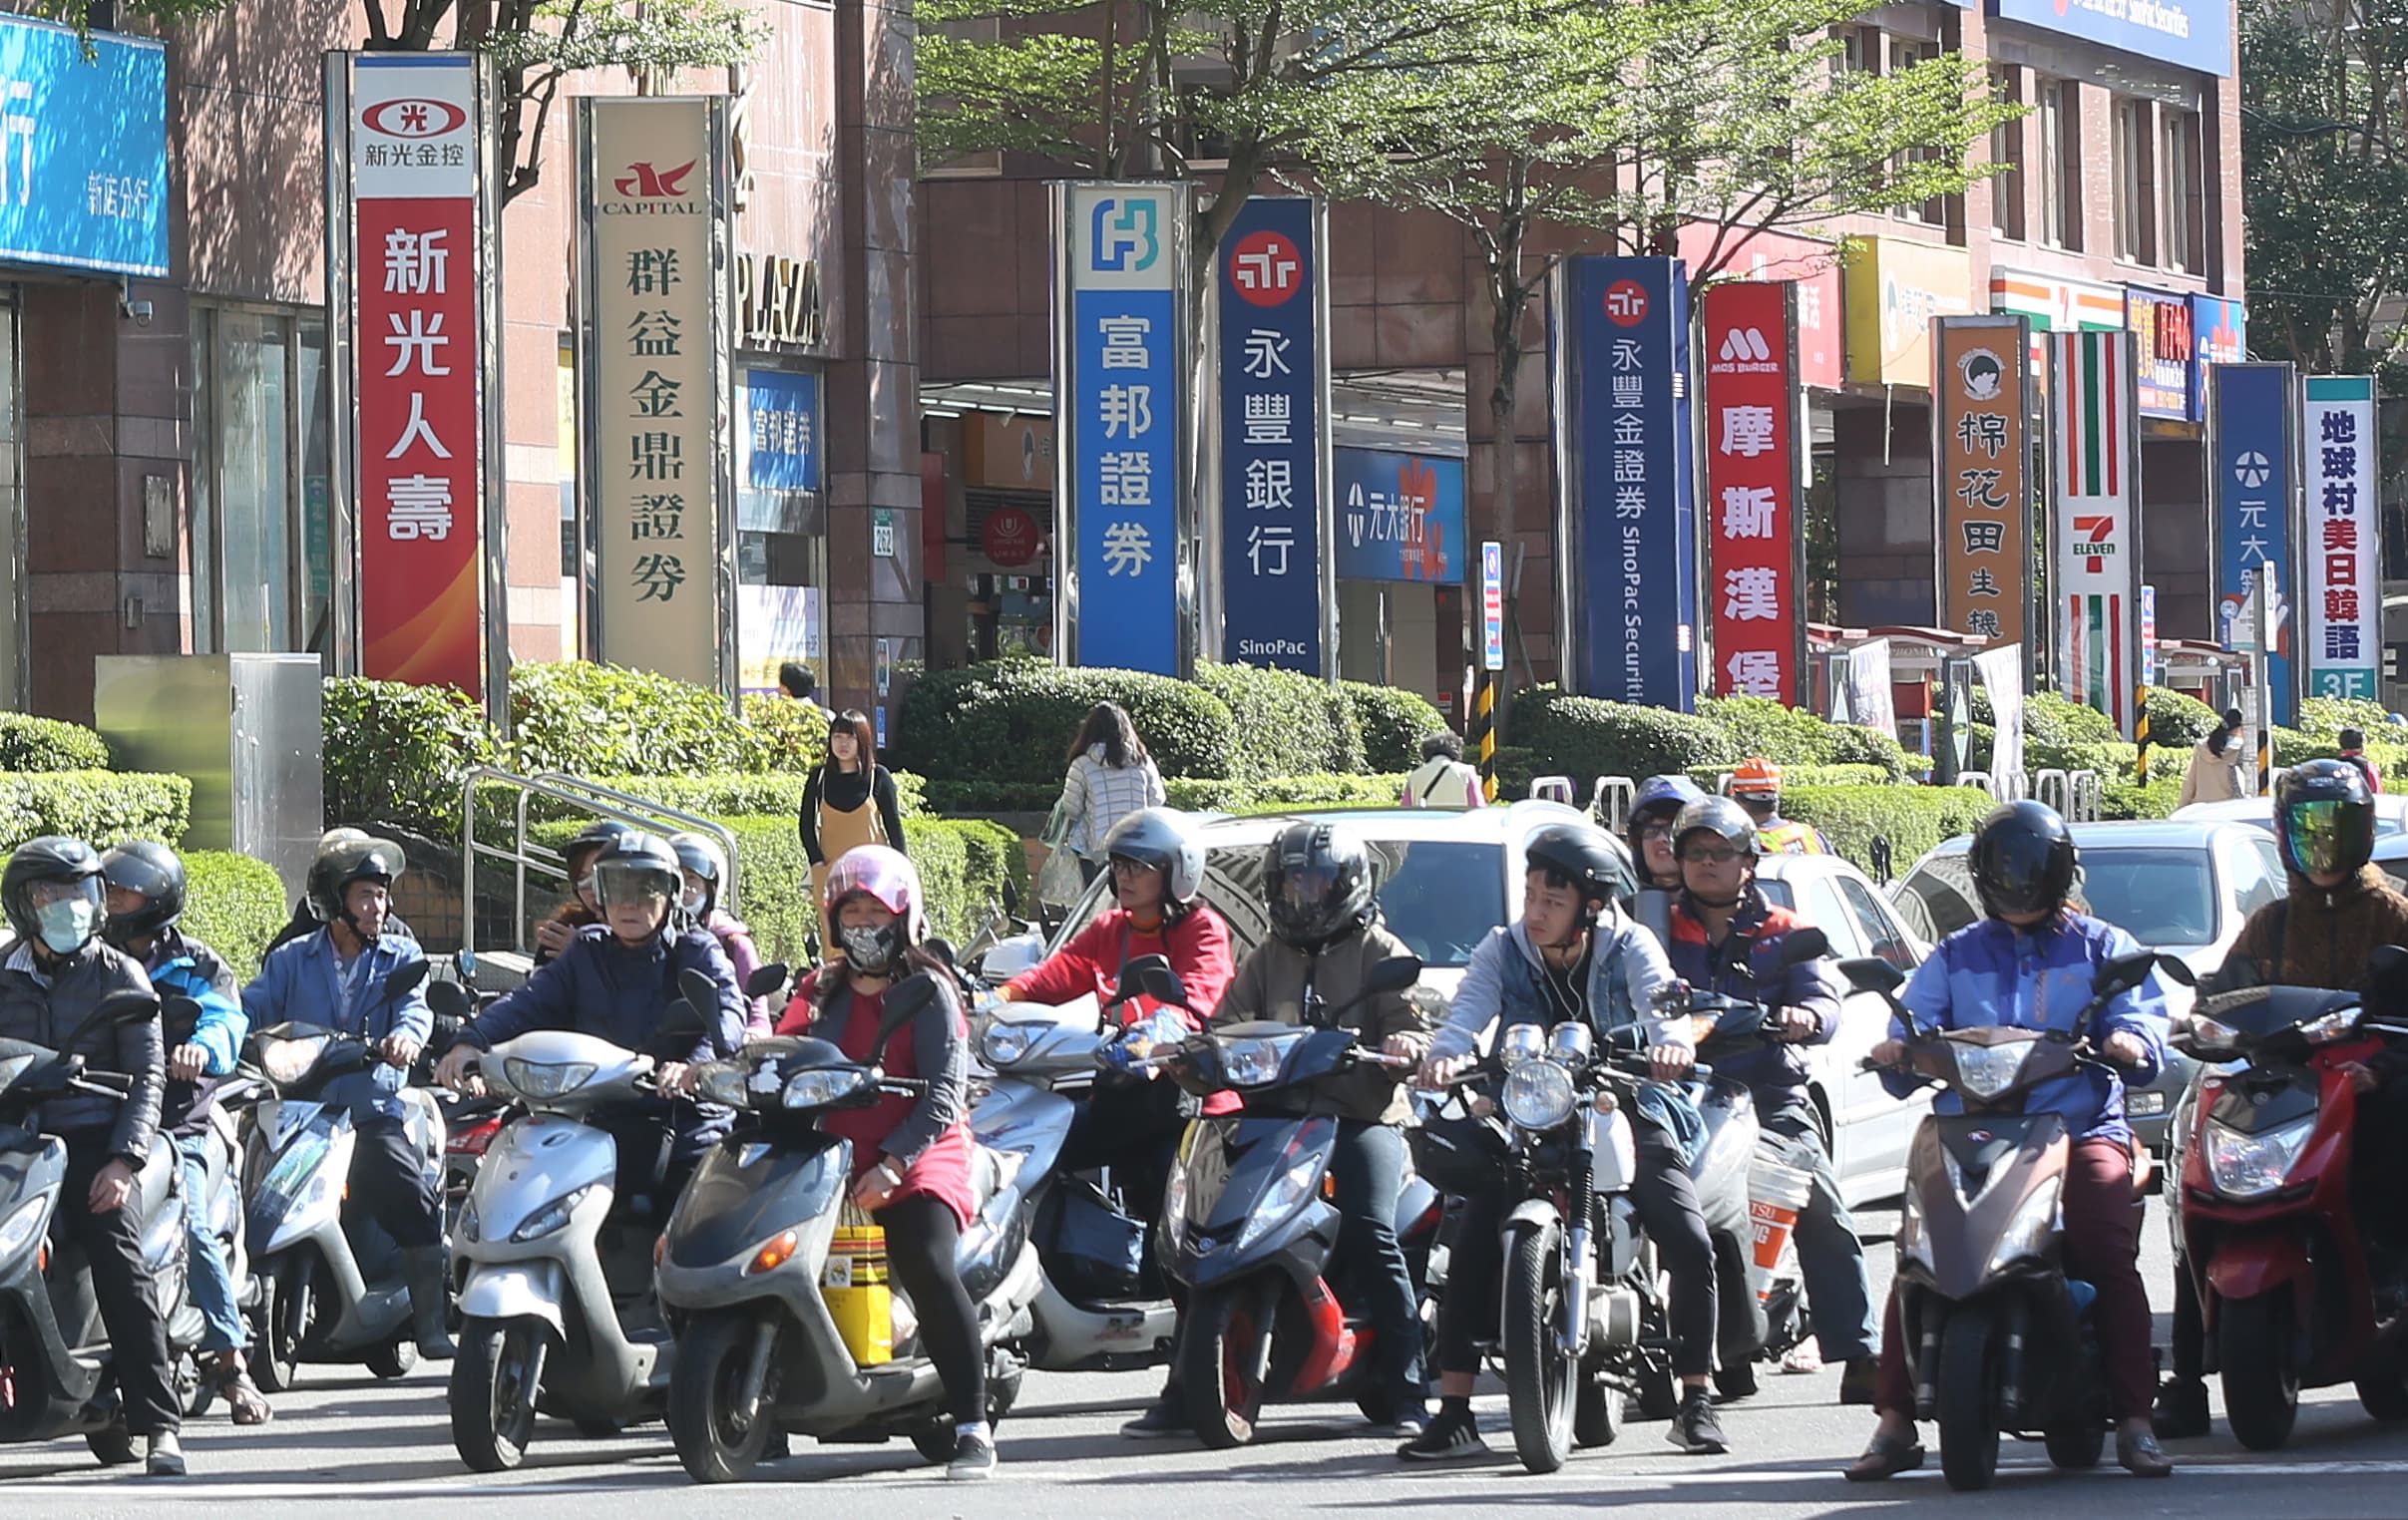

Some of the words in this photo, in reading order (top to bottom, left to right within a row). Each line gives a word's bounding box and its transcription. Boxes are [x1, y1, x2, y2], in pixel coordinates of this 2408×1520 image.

[88, 170, 150, 221] 新店分行
[365, 143, 465, 168] 新光金控
[602, 201, 702, 215] CAPITAL
[734, 253, 822, 347] PLAZA
[383, 228, 453, 541] 新光人壽
[1711, 362, 1736, 374] MOS
[1738, 362, 1780, 374] BURGER
[626, 248, 686, 602] 群益金鼎證券
[754, 407, 811, 456] 富邦證券
[1099, 314, 1152, 577] 富邦證券
[1243, 328, 1295, 575] 永豐銀行
[1611, 338, 1646, 520] 永豐金證券
[1370, 492, 1425, 544] 元大銀行
[1720, 405, 1781, 700] 摩斯漢堡
[1957, 411, 2010, 676] 棉花田生機
[2321, 410, 2360, 660] 地球村美日韓語
[1622, 526, 1642, 609] SinoPac
[1239, 638, 1307, 655] SinoPac
[2322, 672, 2364, 699] 3F
